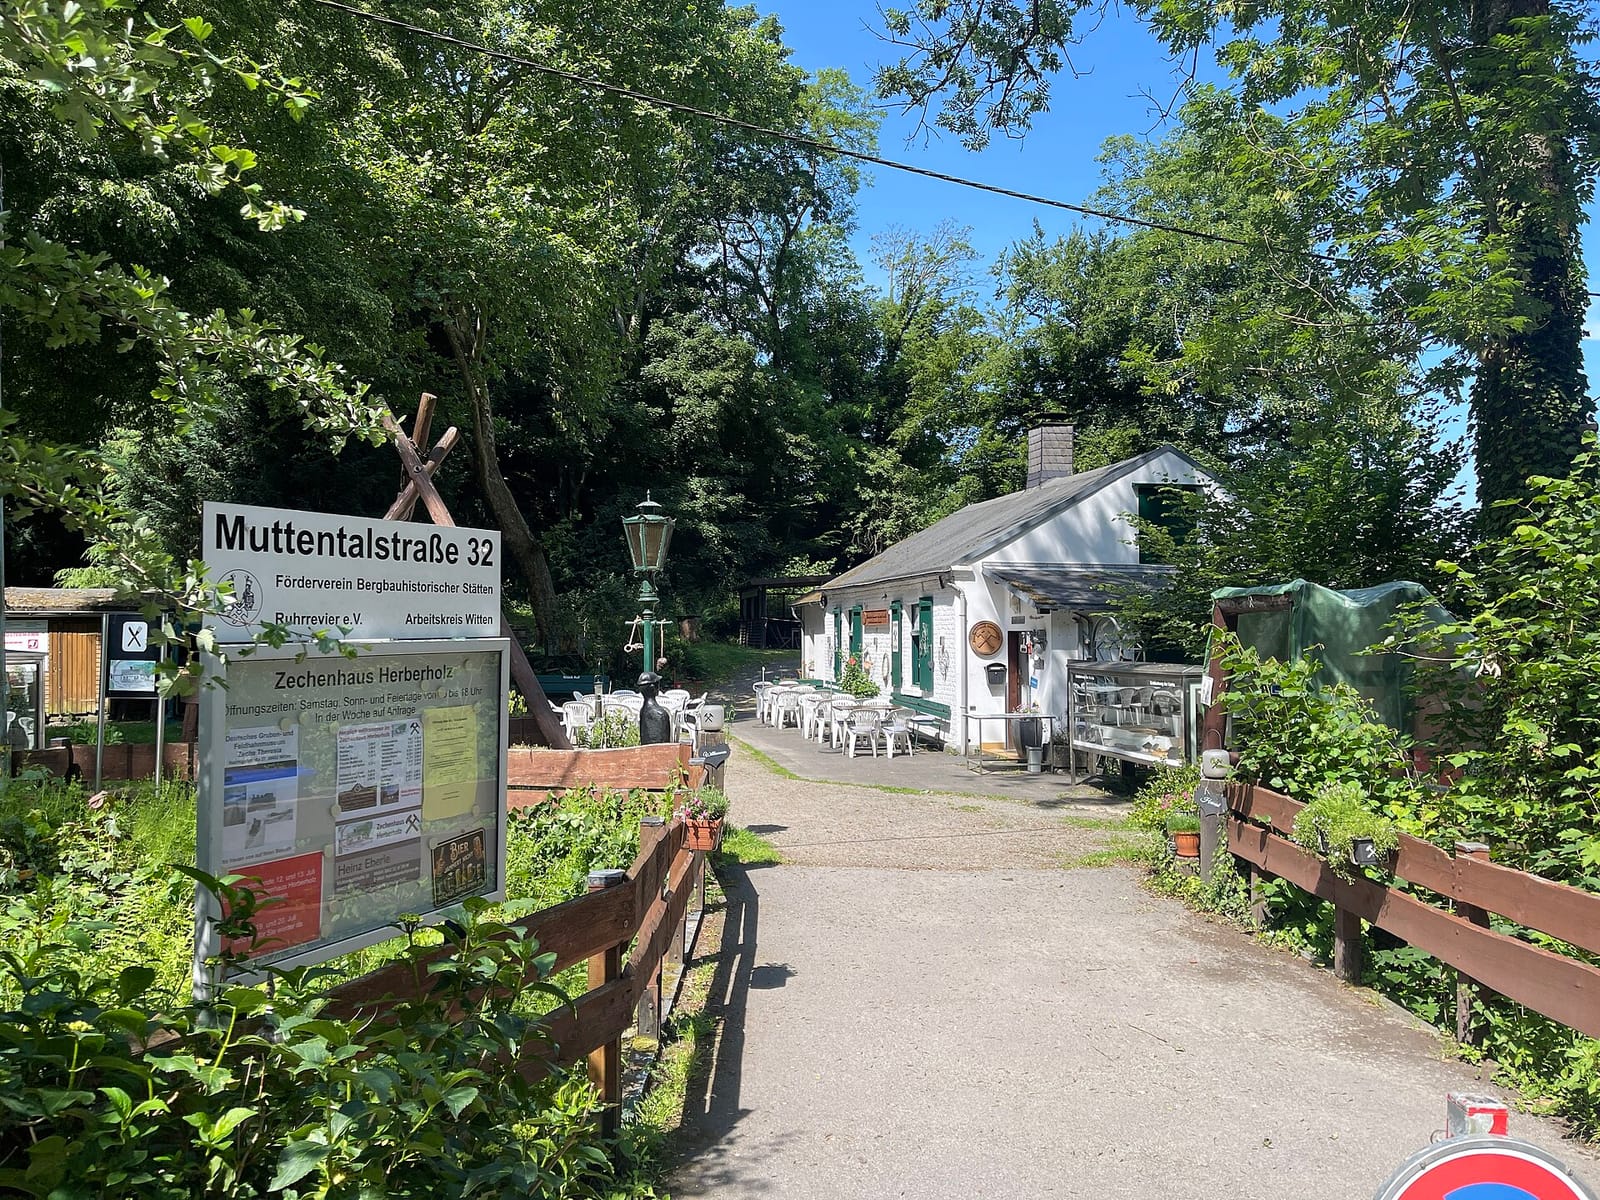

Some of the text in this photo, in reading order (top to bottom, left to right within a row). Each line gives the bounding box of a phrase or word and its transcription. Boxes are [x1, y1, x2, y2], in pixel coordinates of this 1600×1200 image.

[216, 513, 493, 566] Muttentalstraße 32
[275, 574, 494, 594] Förderverein Bergbauhistorischer Stätten
[275, 612, 362, 625] Ruhrrevier e.V.
[405, 613, 494, 625] Arbeitskreis Witten
[274, 664, 454, 690] Zechenhaus Herberholz
[343, 695, 367, 707] Sonn-
[370, 694, 385, 704] und
[387, 691, 422, 703] Feiertage
[326, 711, 340, 722] der
[342, 707, 371, 720] Woche
[373, 706, 386, 717] auf
[387, 705, 416, 716] Anfrage
[337, 863, 363, 876] Heinz
